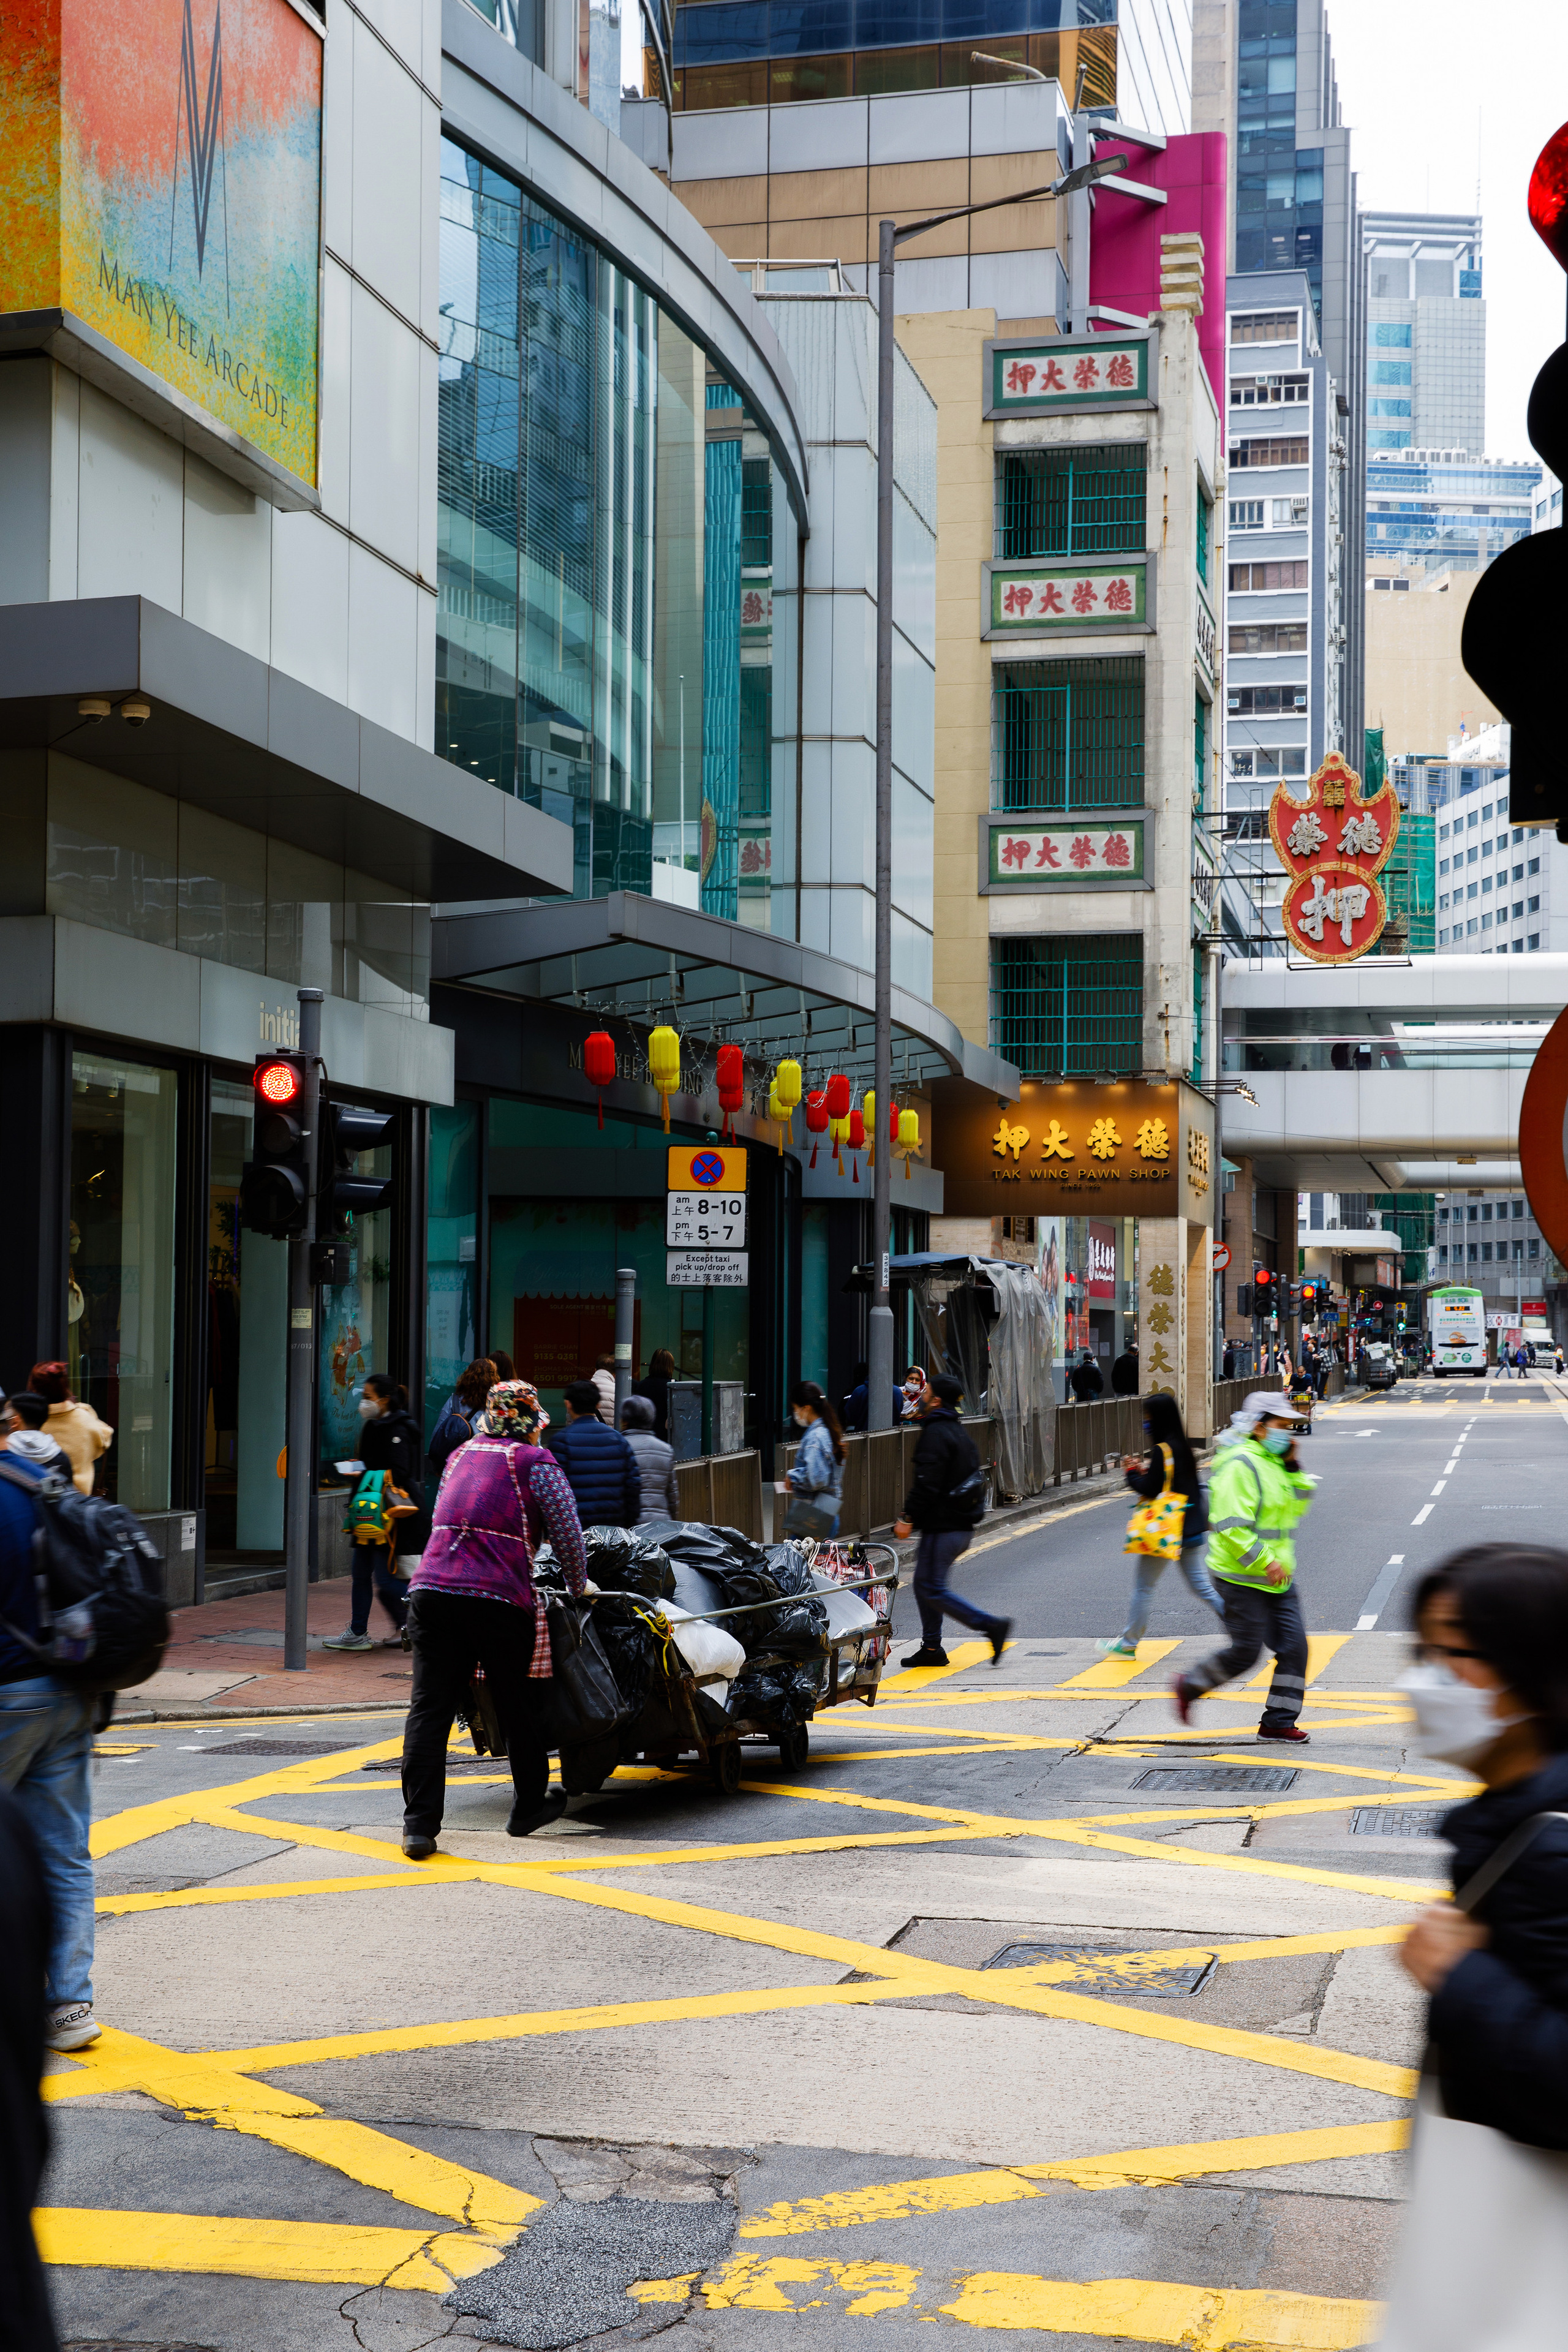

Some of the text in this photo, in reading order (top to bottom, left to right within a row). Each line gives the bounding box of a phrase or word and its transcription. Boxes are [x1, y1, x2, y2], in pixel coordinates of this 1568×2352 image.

[98, 247, 288, 429] MAN YEE ARCADE
[1297, 875, 1371, 946] 押
[992, 1169, 1170, 1179] TAK WING PAWN SHOP
[671, 1205, 695, 1216] 上午
[698, 1199, 742, 1215] 8-10
[671, 1231, 694, 1242] 下午
[686, 1255, 714, 1264] Except
[671, 1273, 743, 1283] 的士上落客除外
